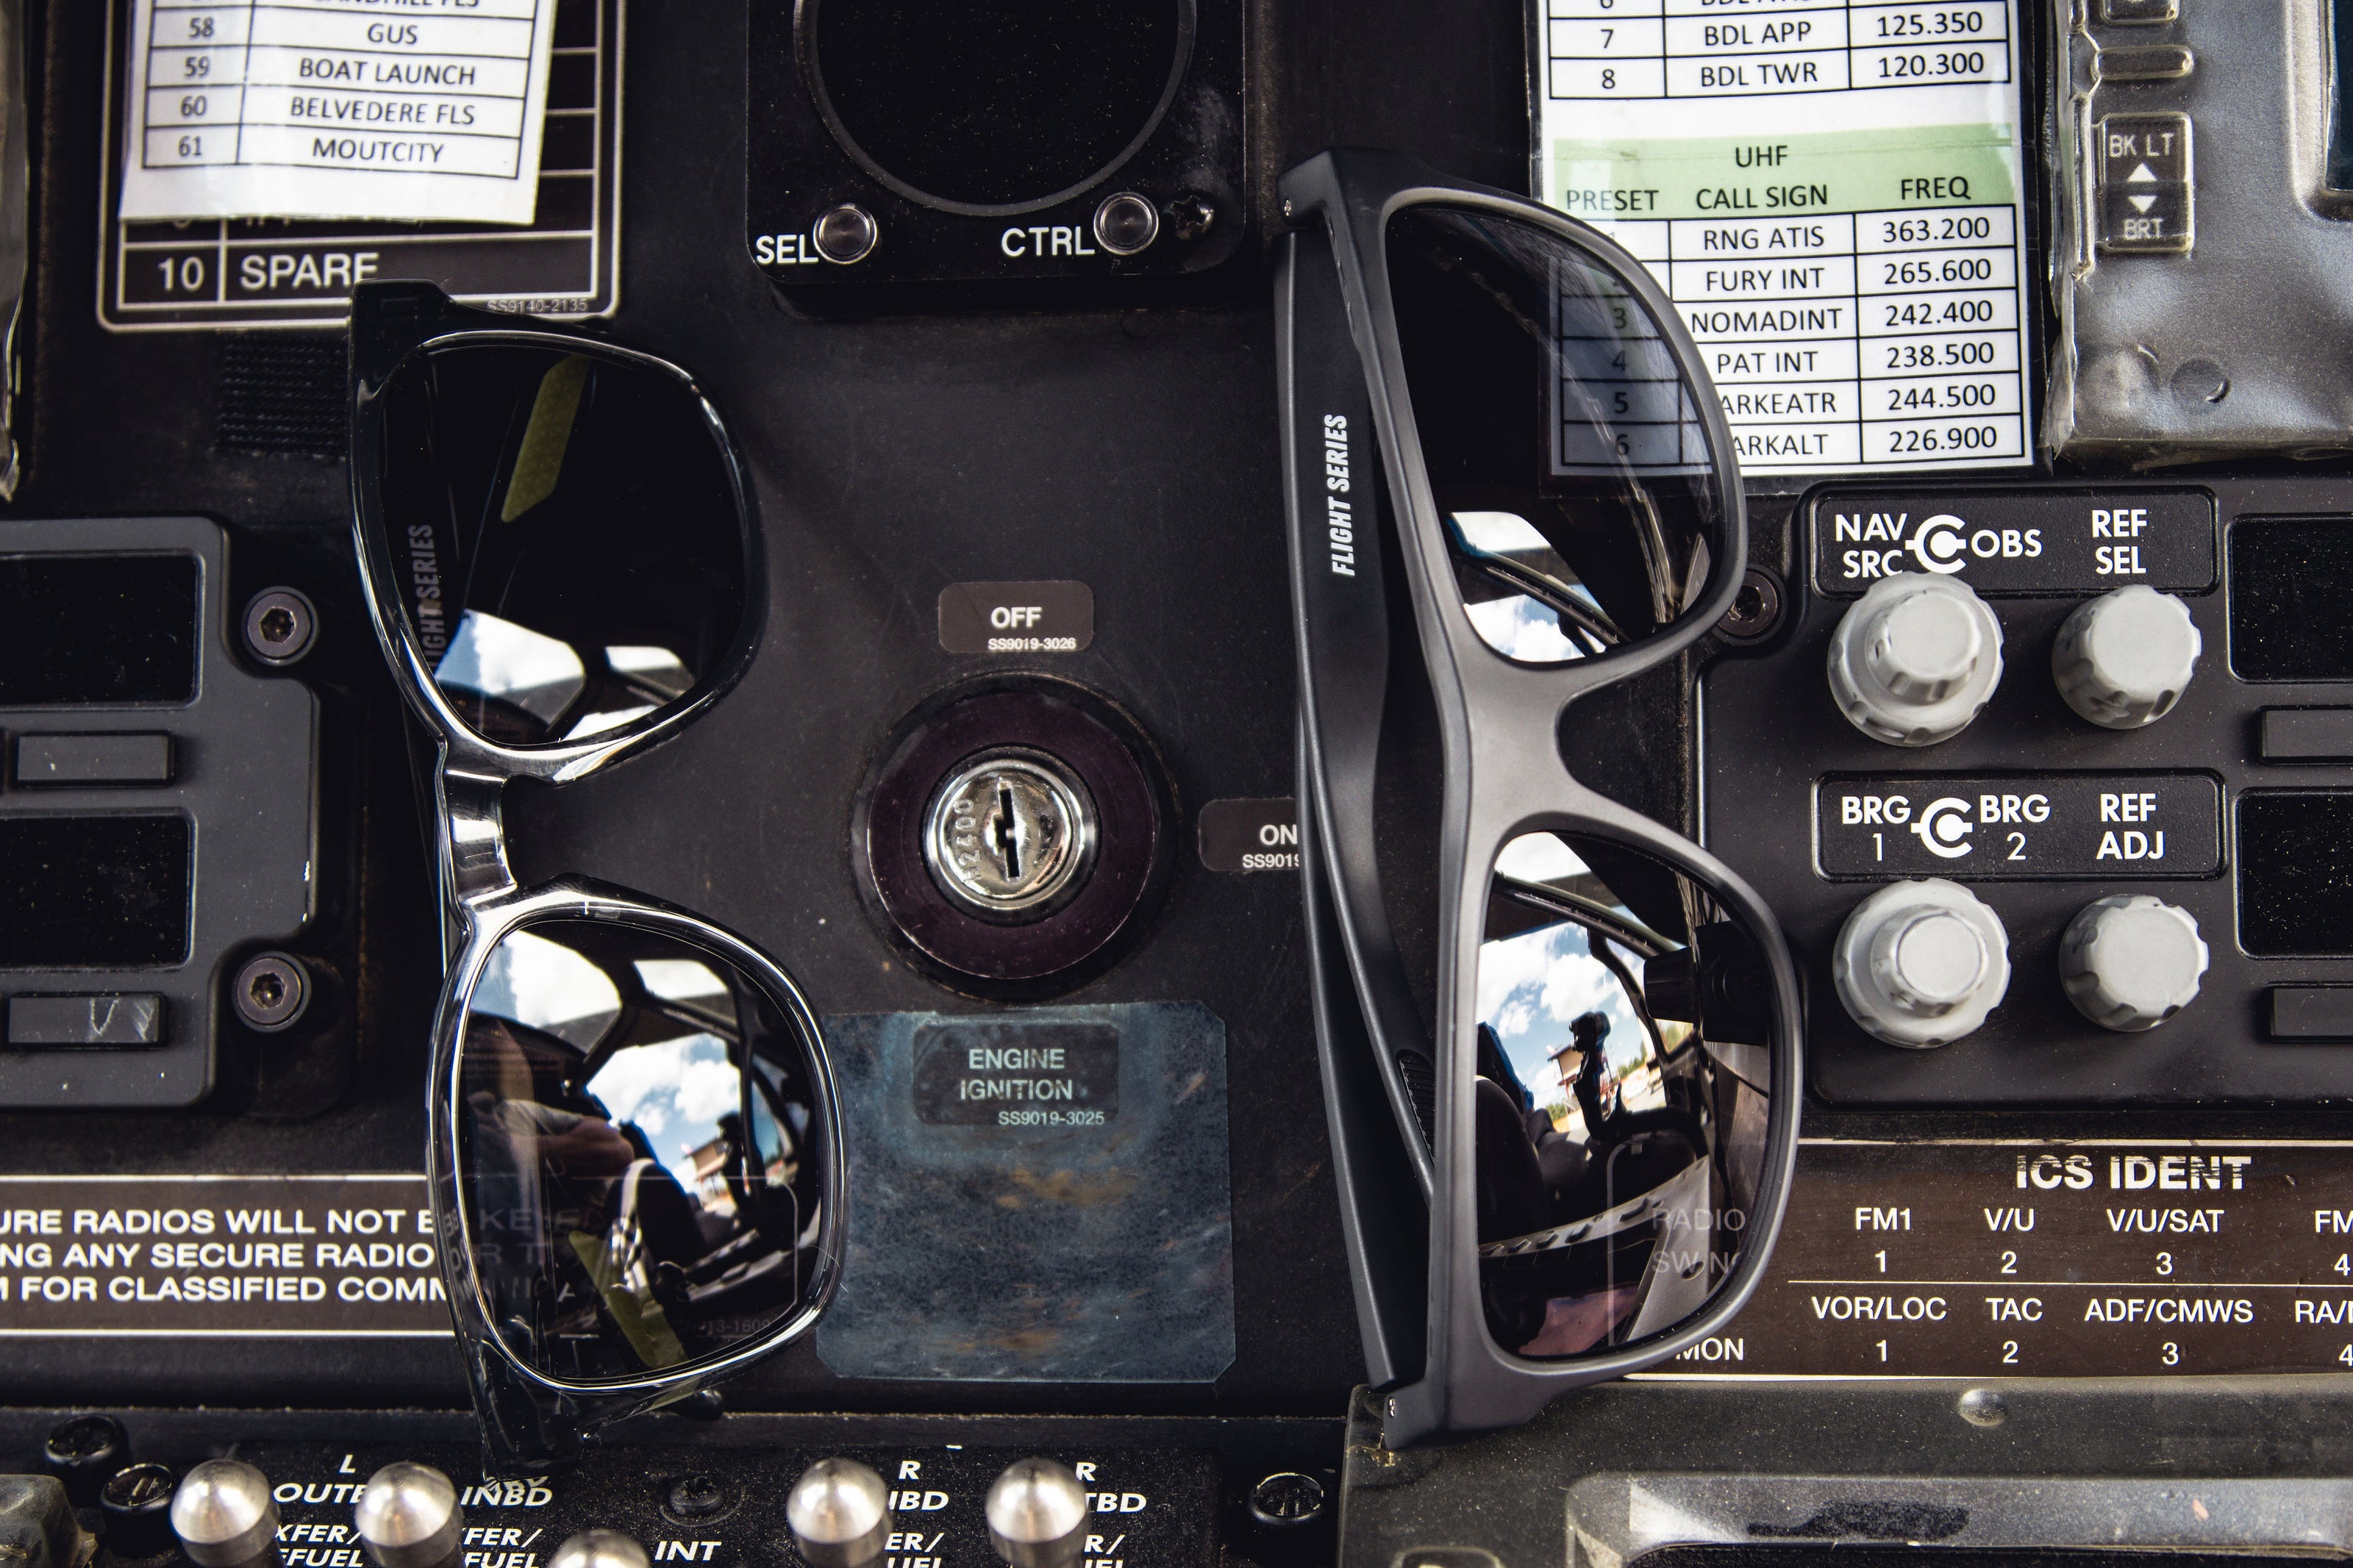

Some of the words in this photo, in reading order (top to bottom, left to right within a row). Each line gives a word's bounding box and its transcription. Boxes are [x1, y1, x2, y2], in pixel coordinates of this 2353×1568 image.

[188, 18, 214, 38] 58
[368, 24, 418, 45] GUS
[1601, 29, 1614, 49] 7
[1704, 26, 1753, 46] BDL
[1761, 22, 1812, 43] APP
[1877, 12, 1983, 37] 125.350
[185, 57, 211, 76] 59
[299, 57, 367, 81] BOAT
[374, 62, 476, 86] LAUNCH
[1602, 70, 1615, 90] 8
[1701, 68, 1749, 87] BDL
[1758, 62, 1818, 85] TWR
[1878, 52, 1985, 78] 120.300
[180, 96, 207, 116] 60
[290, 96, 427, 123] BELVEDERE
[437, 105, 475, 125] FLS
[179, 136, 202, 157] 61
[313, 137, 444, 163] MOUTCITY
[1735, 146, 1788, 168] UHF
[2109, 134, 2138, 158] BK
[2146, 132, 2174, 157] LT
[1567, 190, 1659, 211] PRESET
[1696, 187, 1760, 210] CALL
[1766, 184, 1828, 207] SIGN
[1901, 176, 1971, 201] FREQ
[1001, 226, 1095, 258] CTRL
[1704, 229, 1759, 251] RNG
[1768, 226, 1825, 248] ATIS
[1883, 217, 1990, 243] 363.200
[2124, 218, 2163, 240] BRT
[756, 234, 818, 264] SEL
[158, 257, 204, 290] 10
[1706, 269, 1772, 292] FURY
[1782, 267, 1825, 289] INT
[1884, 258, 1991, 285] 265.600
[487, 298, 588, 313] SS9140-2135
[1613, 307, 1627, 329] 3
[1885, 300, 1993, 326] 242.400
[1613, 349, 1627, 370] 4
[1717, 351, 1766, 373] PAT
[1776, 350, 1818, 372] INT
[1886, 341, 1994, 368] 238.500
[1614, 392, 1628, 414] 5
[1721, 393, 1837, 415] ARKEATR
[1888, 383, 1996, 410] 244.500
[1324, 414, 1350, 493] SERIES
[1615, 434, 1629, 456] 6
[1734, 434, 1829, 456] ARKALT
[1889, 425, 1998, 453] 226.900
[1327, 495, 1355, 577] FLIGHT
[1836, 513, 1907, 542] NAV
[1971, 529, 2043, 558] OBS
[2092, 509, 2147, 537] REF
[407, 524, 440, 599] SERIES
[1843, 549, 1903, 579] SRC
[2096, 545, 2146, 574] SEL
[990, 606, 1041, 629] OFF
[988, 637, 1076, 651] SS9019-3026
[1842, 795, 1911, 824] BRG
[1980, 794, 2050, 823] BRG
[2101, 793, 2157, 822] REF
[1260, 824, 1298, 845] ON
[1872, 833, 1884, 862] 1
[2007, 831, 2027, 860] 2
[2096, 831, 2165, 860] ADJ
[968, 1048, 1065, 1070] ENGINE
[960, 1080, 1074, 1101] IGNITION
[998, 1111, 1105, 1126] SS9019-3025
[2017, 1155, 2093, 1189] ICS
[2110, 1156, 2252, 1189] IDENT
[74, 1209, 215, 1234] RADIOS
[226, 1209, 316, 1234] WILL
[328, 1209, 407, 1234] NOT
[1653, 1209, 1746, 1231] RADIO
[1855, 1208, 1912, 1233] FM1
[1985, 1208, 2035, 1233] V/U
[2107, 1209, 2225, 1234] V/U/SAT
[63, 1243, 140, 1267] ANY
[151, 1243, 304, 1268] SECURE
[1876, 1251, 1887, 1274] 1
[2002, 1251, 2017, 1275] 2
[2156, 1252, 2173, 1276] 3
[2334, 1253, 2351, 1276] 4
[21, 1276, 98, 1301] FOR
[109, 1276, 326, 1302] CLASSIFIED
[1812, 1296, 1947, 1322] VOR/LOC
[1987, 1297, 2043, 1322] TAC
[2085, 1297, 2254, 1324] ADF/CMWS
[2295, 1300, 2353, 1324] RA/
[1877, 1339, 1888, 1363] 1
[2003, 1340, 2018, 1364] 2
[2163, 1342, 2179, 1367] 3
[2339, 1344, 2353, 1367] 4
[340, 1455, 355, 1474] L
[899, 1461, 921, 1480] R
[1076, 1462, 1096, 1482] R
[463, 1528, 543, 1548] FER/
[654, 1542, 722, 1561] INT
[279, 1548, 363, 1567] FUEL
